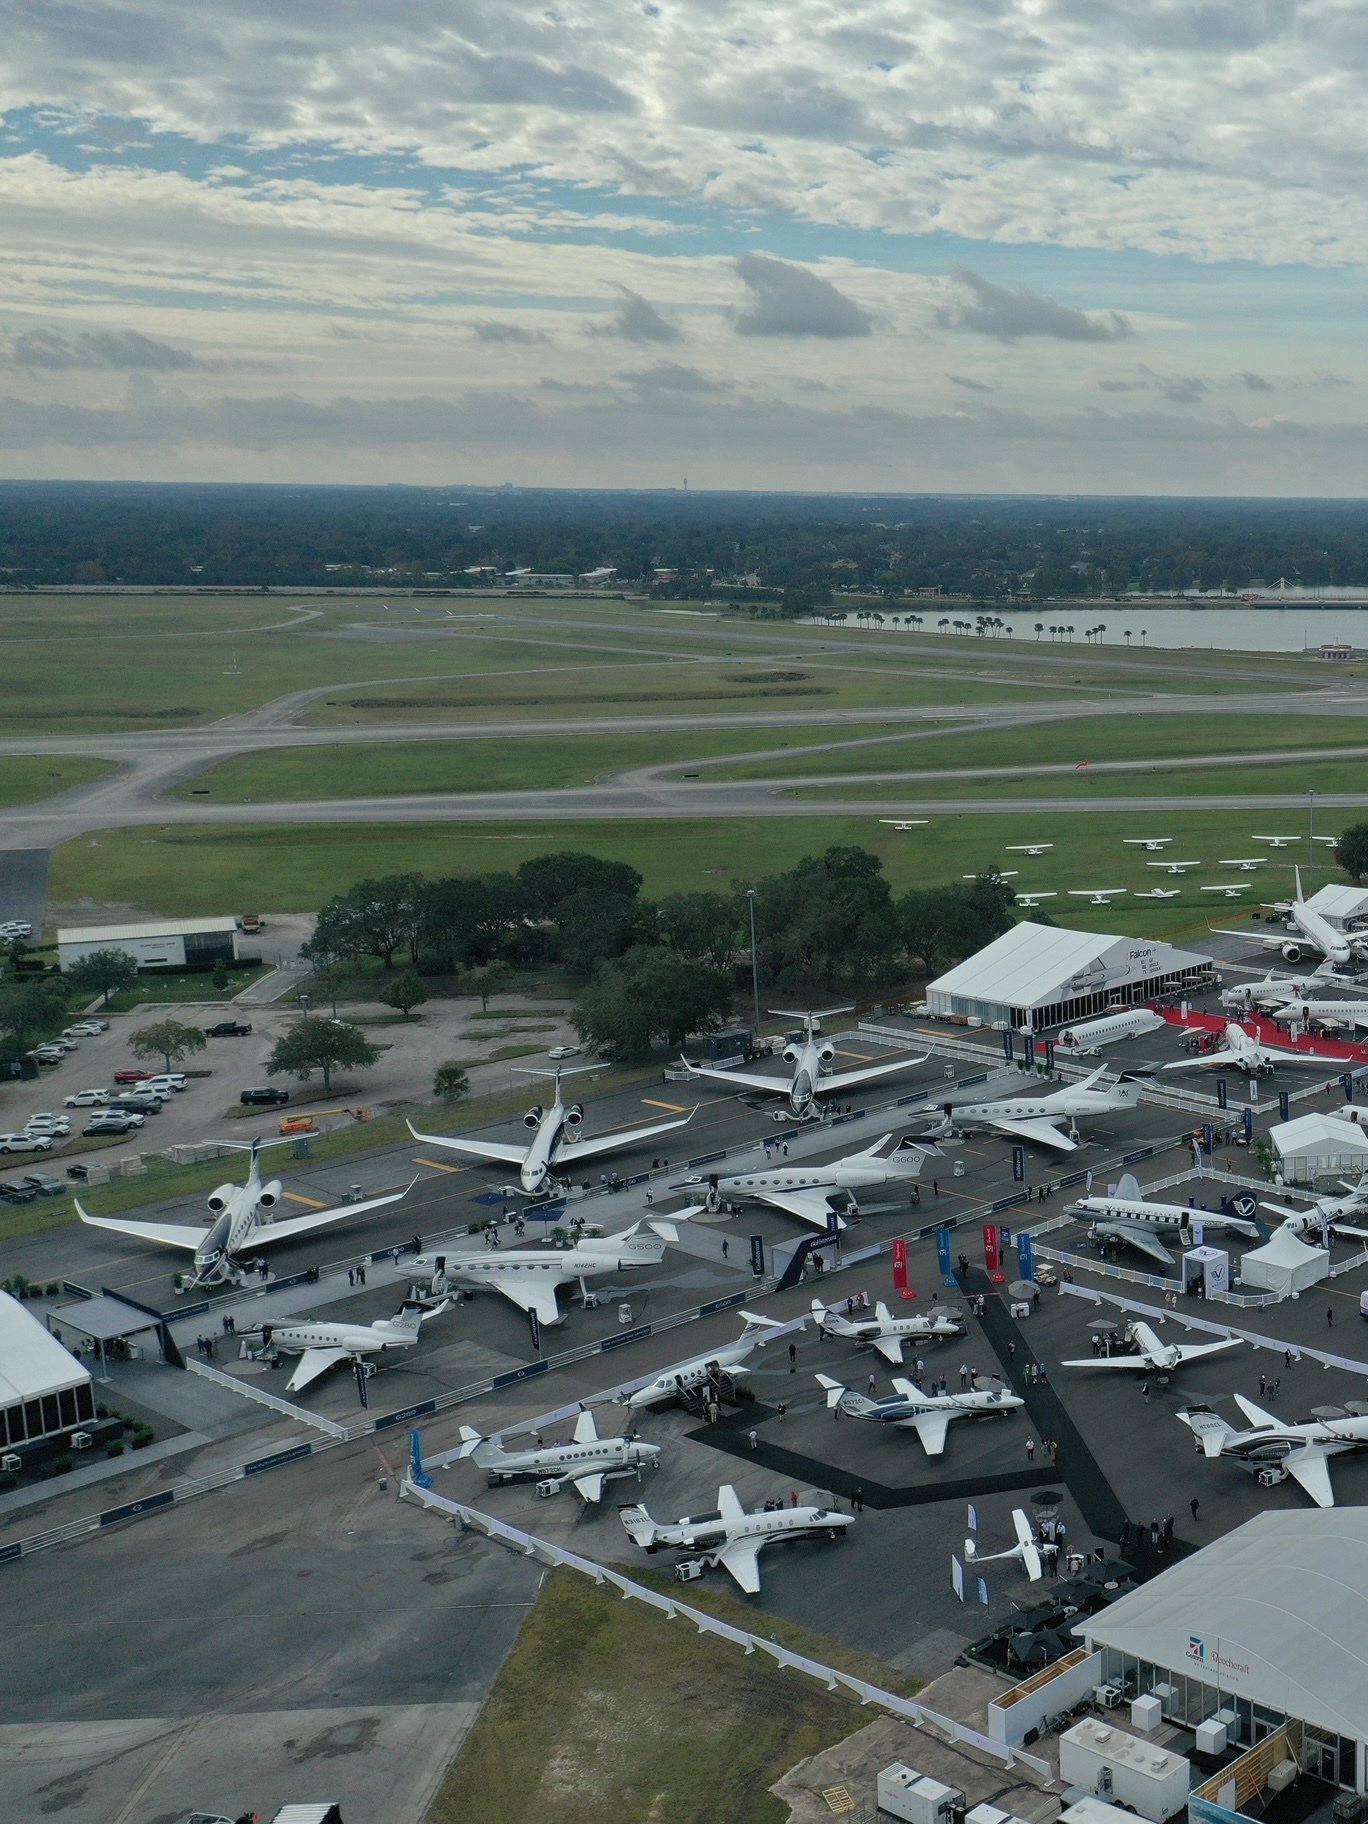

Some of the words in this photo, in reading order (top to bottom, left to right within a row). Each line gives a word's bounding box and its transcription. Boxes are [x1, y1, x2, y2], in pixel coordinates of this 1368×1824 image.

[1129, 948, 1152, 960] Falcon
[810, 1234, 836, 1248] Gulfstream
[392, 1320, 416, 1329] G280
[395, 1409, 416, 1421] G280
[1185, 1651, 1204, 1663] Cessna
[1211, 1650, 1249, 1675] Beechcraft
